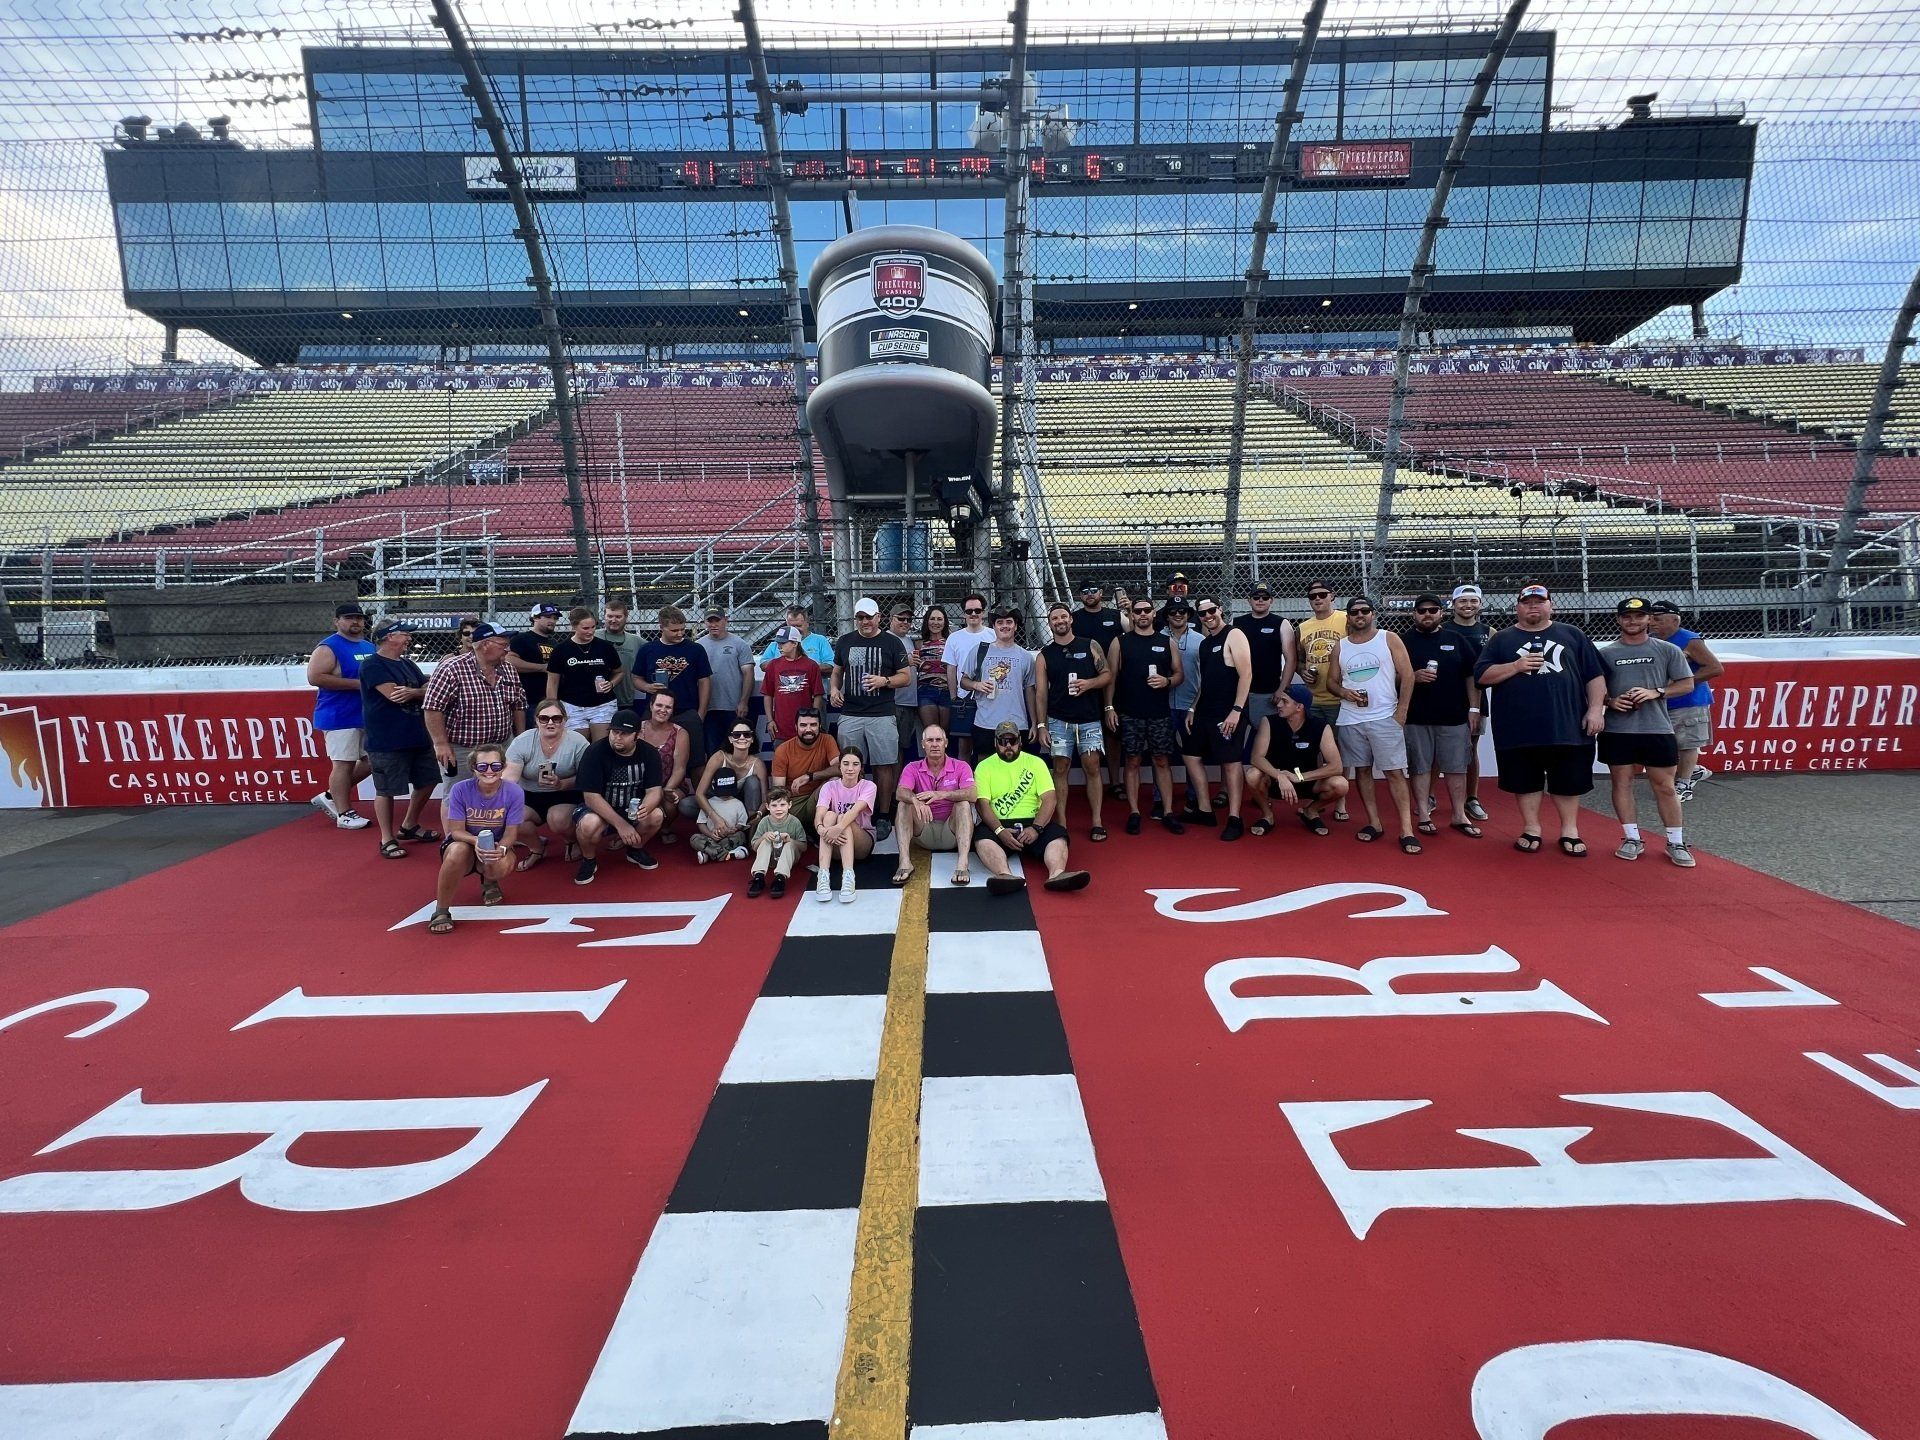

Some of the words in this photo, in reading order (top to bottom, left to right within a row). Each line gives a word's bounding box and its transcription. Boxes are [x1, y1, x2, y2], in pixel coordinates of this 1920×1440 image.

[880, 296, 918, 308] 400
[886, 330, 920, 342] NASCAR
[878, 342, 894, 352] CUP
[894, 342, 920, 352] SERIES
[1290, 364, 1311, 376] ally
[1469, 362, 1489, 373] ally
[1528, 361, 1550, 372] ally
[1051, 370, 1071, 382] ally
[1110, 370, 1130, 381] ally
[1169, 368, 1189, 381] ally
[387, 379, 407, 390] ally
[508, 377, 528, 389] ally
[628, 376, 649, 387] ally
[691, 375, 712, 387] ally
[751, 375, 772, 387] ally
[1710, 681, 1918, 729] REKEEPER
[1821, 738, 1903, 753] HOTEL
[1724, 759, 1794, 771] BATTLE
[1809, 758, 1869, 769] CREEK
[108, 772, 210, 789] CASINO
[235, 769, 318, 786] HOTEL
[143, 792, 214, 804] BATTLE
[229, 790, 290, 802] CREEK
